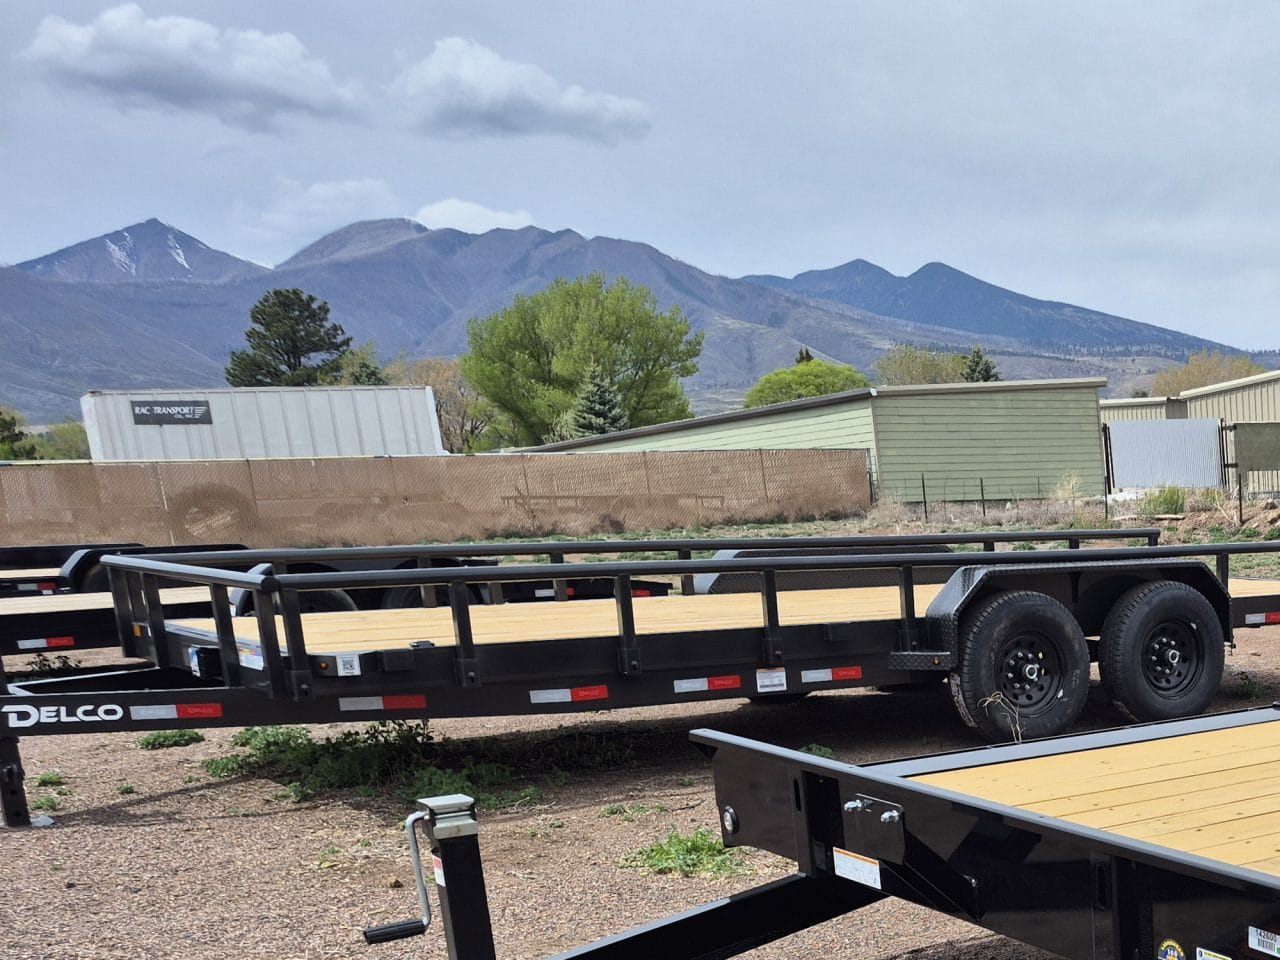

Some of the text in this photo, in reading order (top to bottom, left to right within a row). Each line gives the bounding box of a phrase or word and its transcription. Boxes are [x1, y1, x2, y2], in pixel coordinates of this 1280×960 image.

[134, 406, 194, 414] RAC TRANSPORT
[1, 704, 124, 728] DELCO
